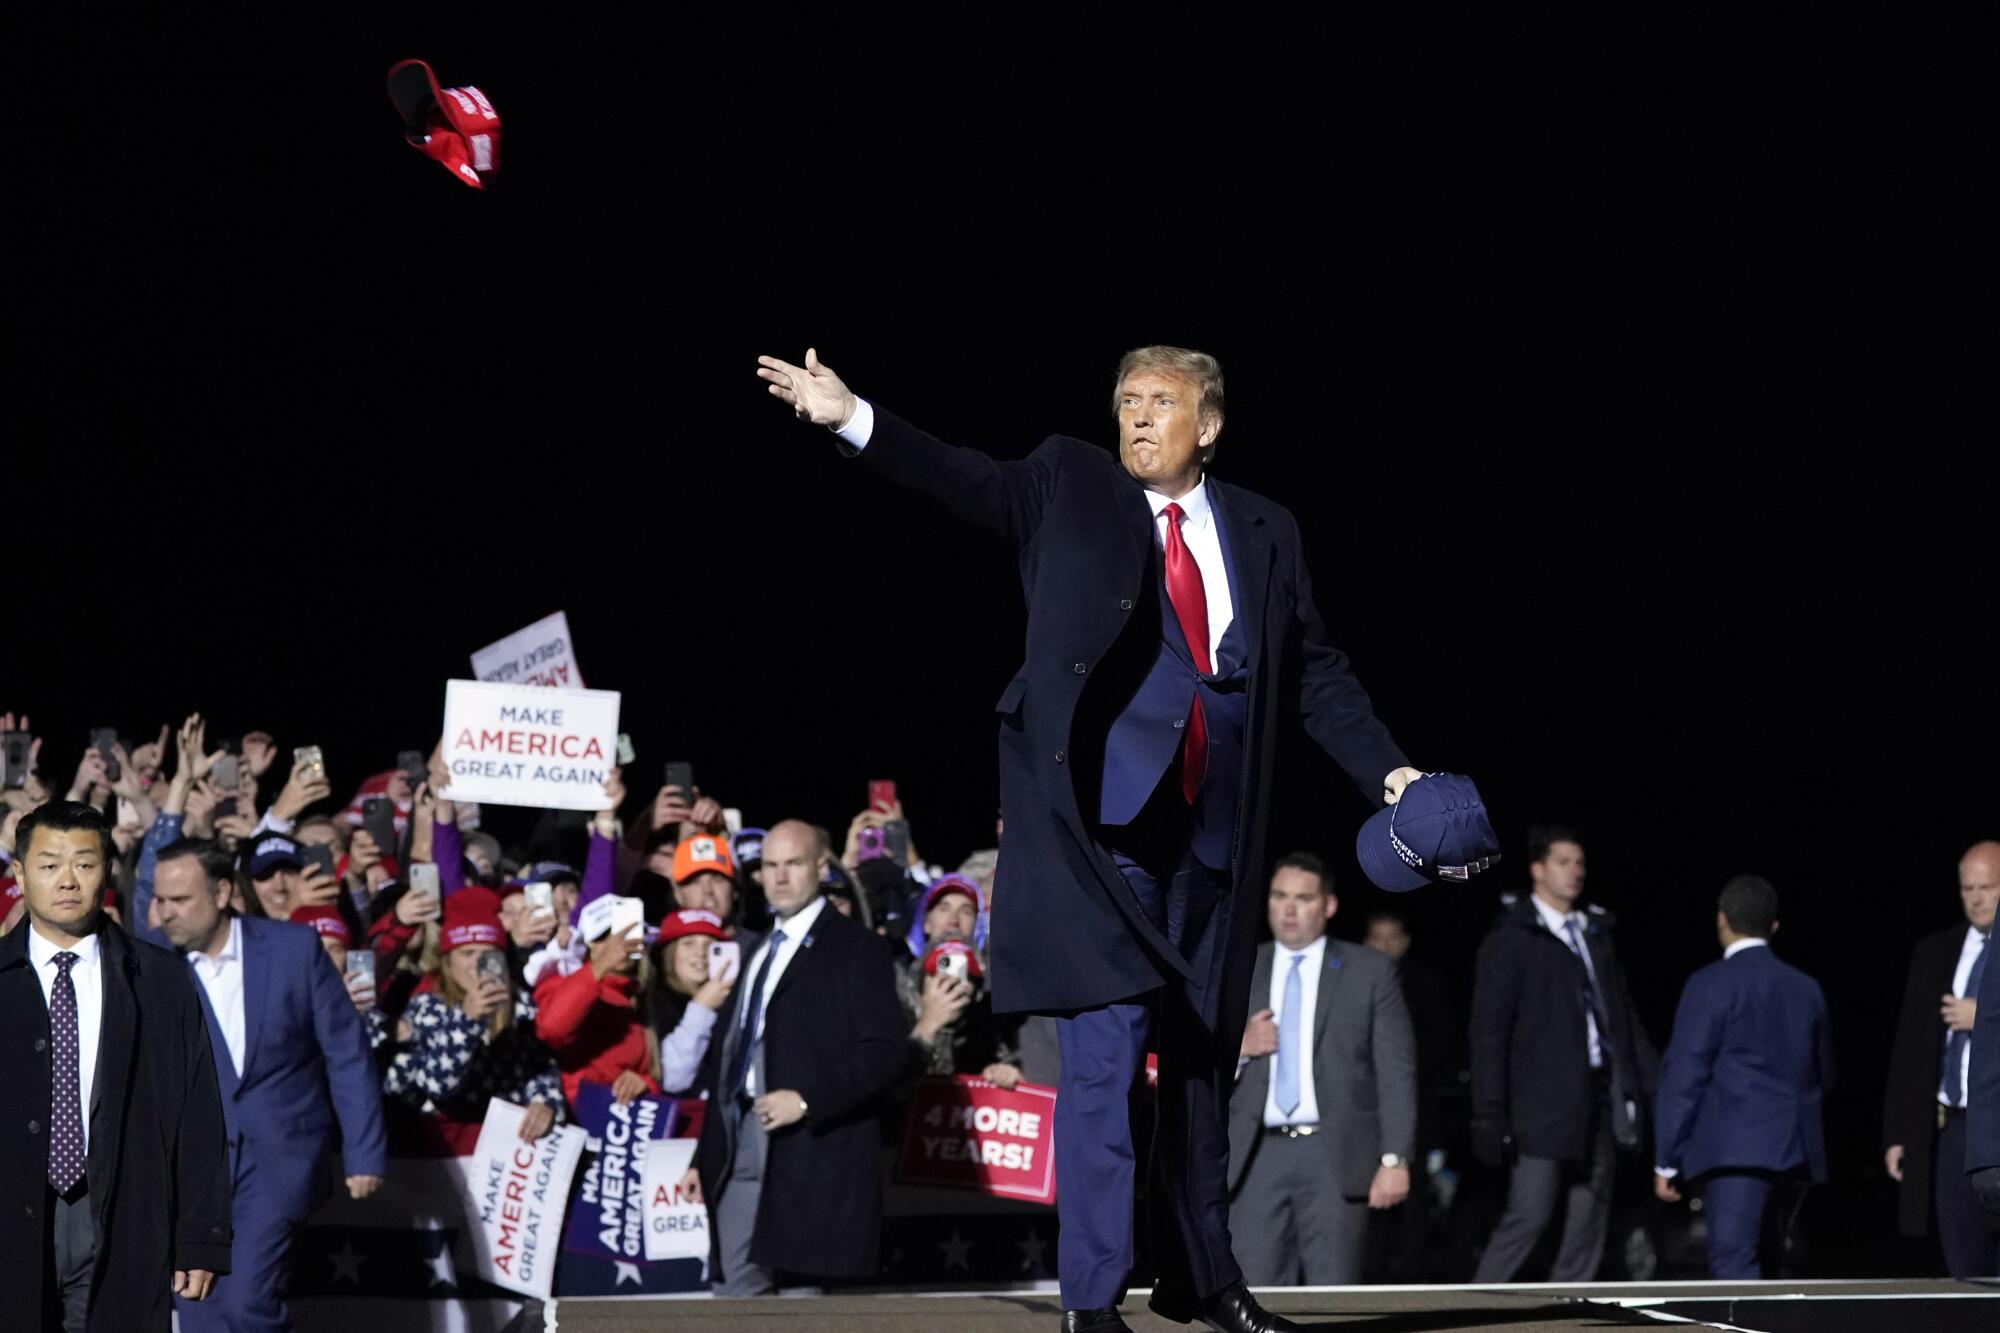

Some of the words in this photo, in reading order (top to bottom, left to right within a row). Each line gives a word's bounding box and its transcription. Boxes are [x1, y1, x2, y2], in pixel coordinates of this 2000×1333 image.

[455, 728, 604, 760] AMERICA
[499, 706, 564, 726] MAKE
[452, 759, 526, 779] GREAT
[532, 765, 604, 784] AGAIN
[630, 1100, 660, 1177] AGAIN
[921, 1135, 1034, 1171] YEARS!
[924, 1105, 944, 1127] 4
[950, 1105, 1041, 1140] MORE
[481, 1159, 505, 1223] MAKE
[581, 1136, 602, 1204] MAE
[599, 1101, 634, 1253] AMERICA
[493, 1138, 537, 1276] AMERIC
[519, 1211, 541, 1282] GREAT
[533, 1129, 564, 1204] AGAIN
[623, 1178, 645, 1257] GREAT
[653, 1213, 708, 1233] GREA
